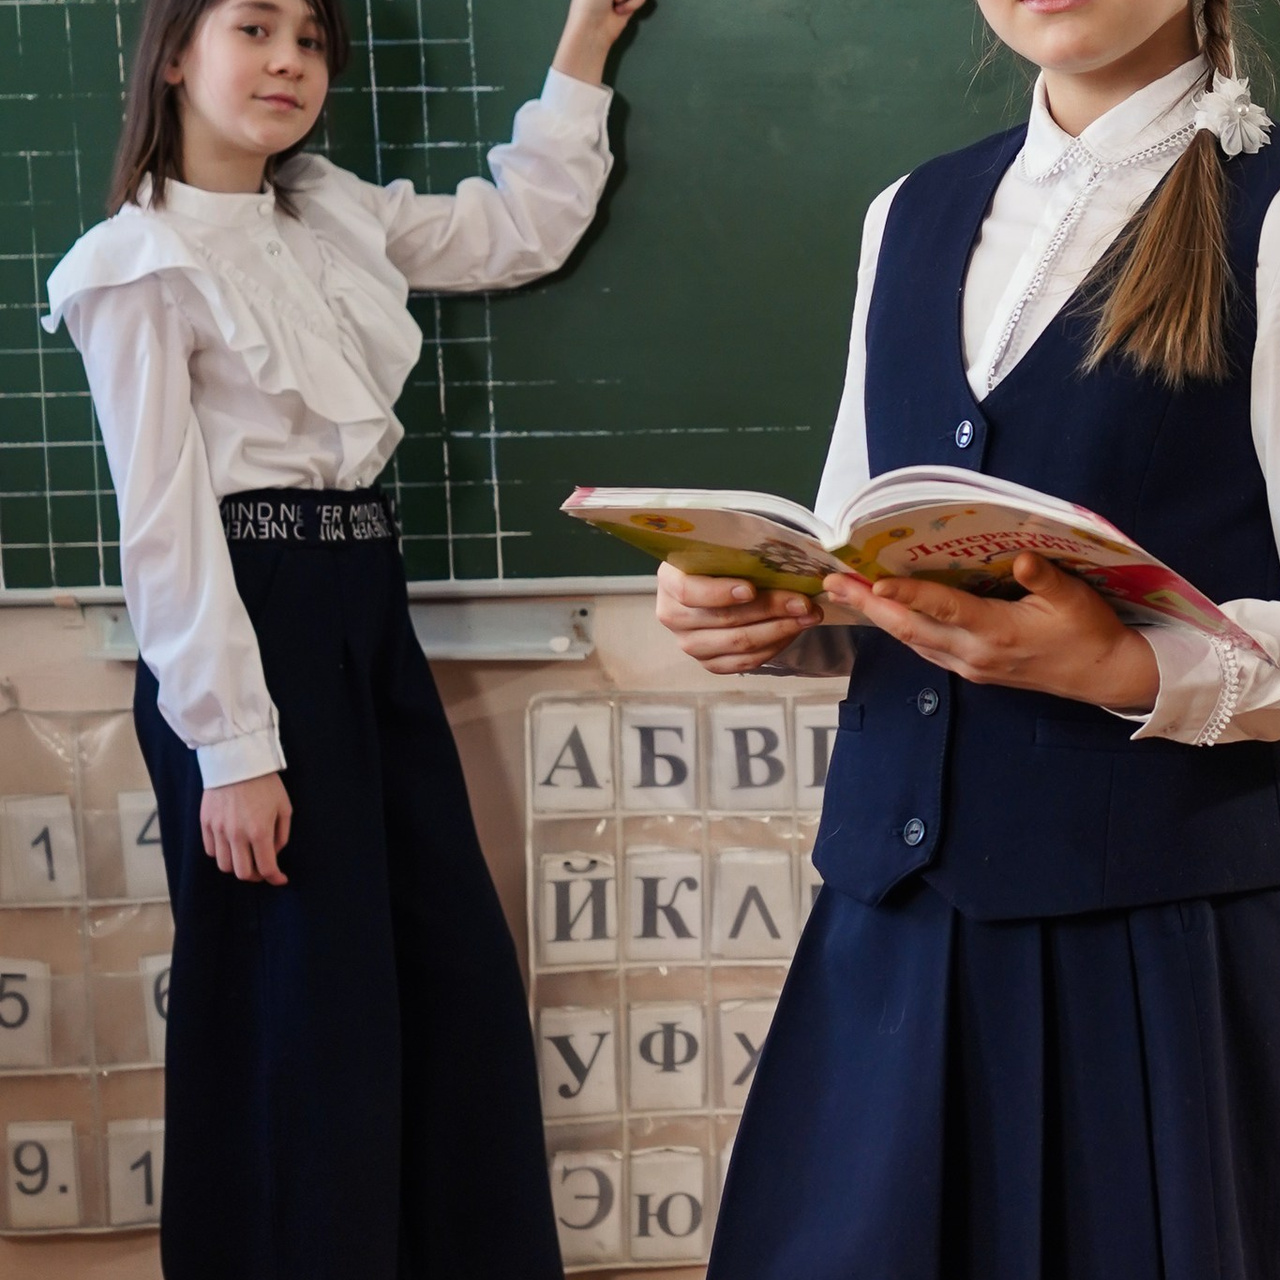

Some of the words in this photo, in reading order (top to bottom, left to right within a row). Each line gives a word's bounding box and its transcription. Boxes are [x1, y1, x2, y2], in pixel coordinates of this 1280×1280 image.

[538, 725, 603, 789] А
[632, 725, 690, 788] Б
[724, 726, 786, 790] В
[31, 826, 56, 882] 1
[547, 859, 613, 943] Й
[633, 875, 699, 939] К
[544, 1031, 611, 1100] У
[638, 1022, 699, 1073] Ф
[558, 1165, 614, 1231] Э
[633, 1191, 703, 1238] Ю
